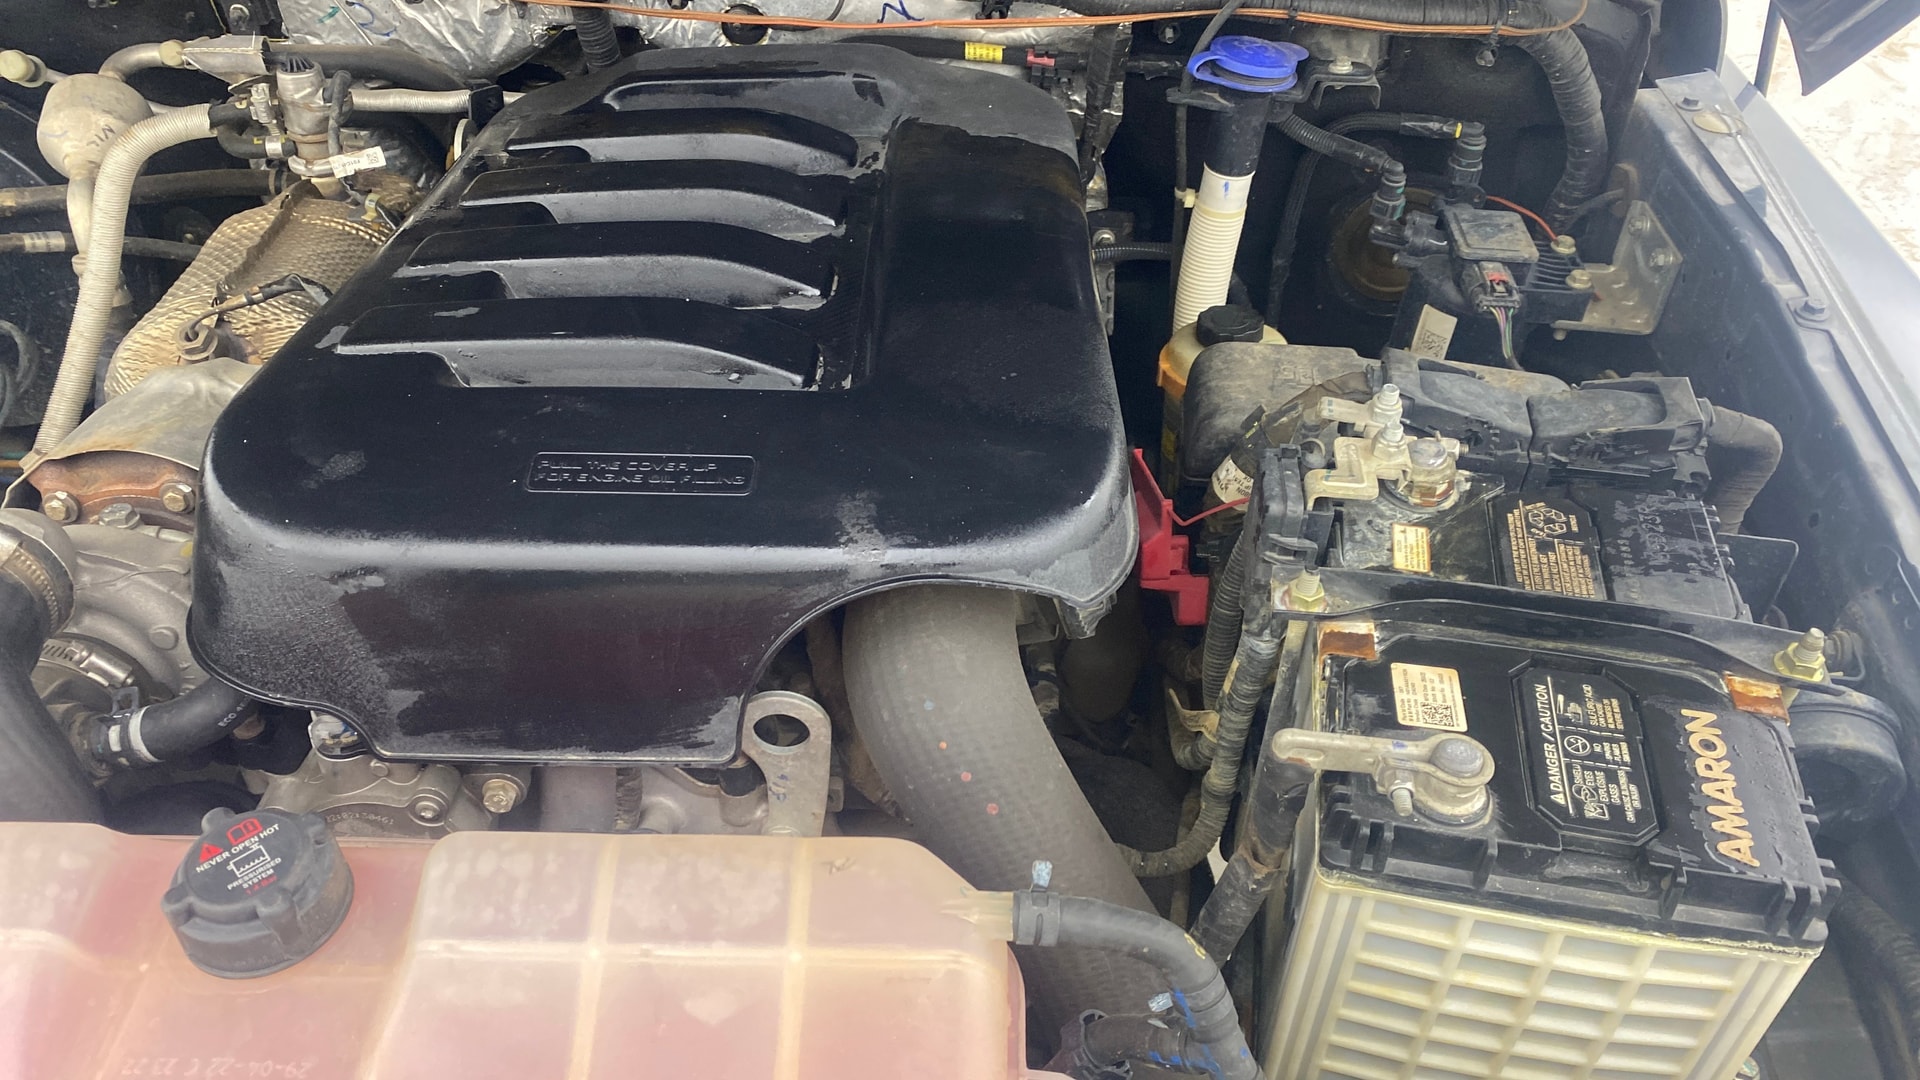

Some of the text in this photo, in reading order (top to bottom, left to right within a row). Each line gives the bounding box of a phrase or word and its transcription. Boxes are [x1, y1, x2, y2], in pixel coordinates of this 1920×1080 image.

[538, 460, 717, 472] PULL THE COVER UP
[535, 473, 745, 485] FOR ENGINE OIL FILLING
[1582, 684, 1599, 726] SULFURIC ACID
[1535, 684, 1563, 792] DANGER / CAUTION
[1593, 743, 1603, 753] NO
[1572, 763, 1584, 786] SHIELD
[1584, 771, 1595, 786] EYES
[1595, 771, 1609, 802] EXPLOSIVE
[1608, 784, 1621, 804] GASES
[1617, 770, 1636, 823] CAN CAUSE BLINDNESS
[1629, 784, 1639, 801] INJURY
[1681, 708, 1760, 868] AMARON
[196, 823, 279, 873] NEVER OPEN HOT
[227, 857, 281, 890] PRESSURISED
[242, 868, 274, 888] SYSTEM
